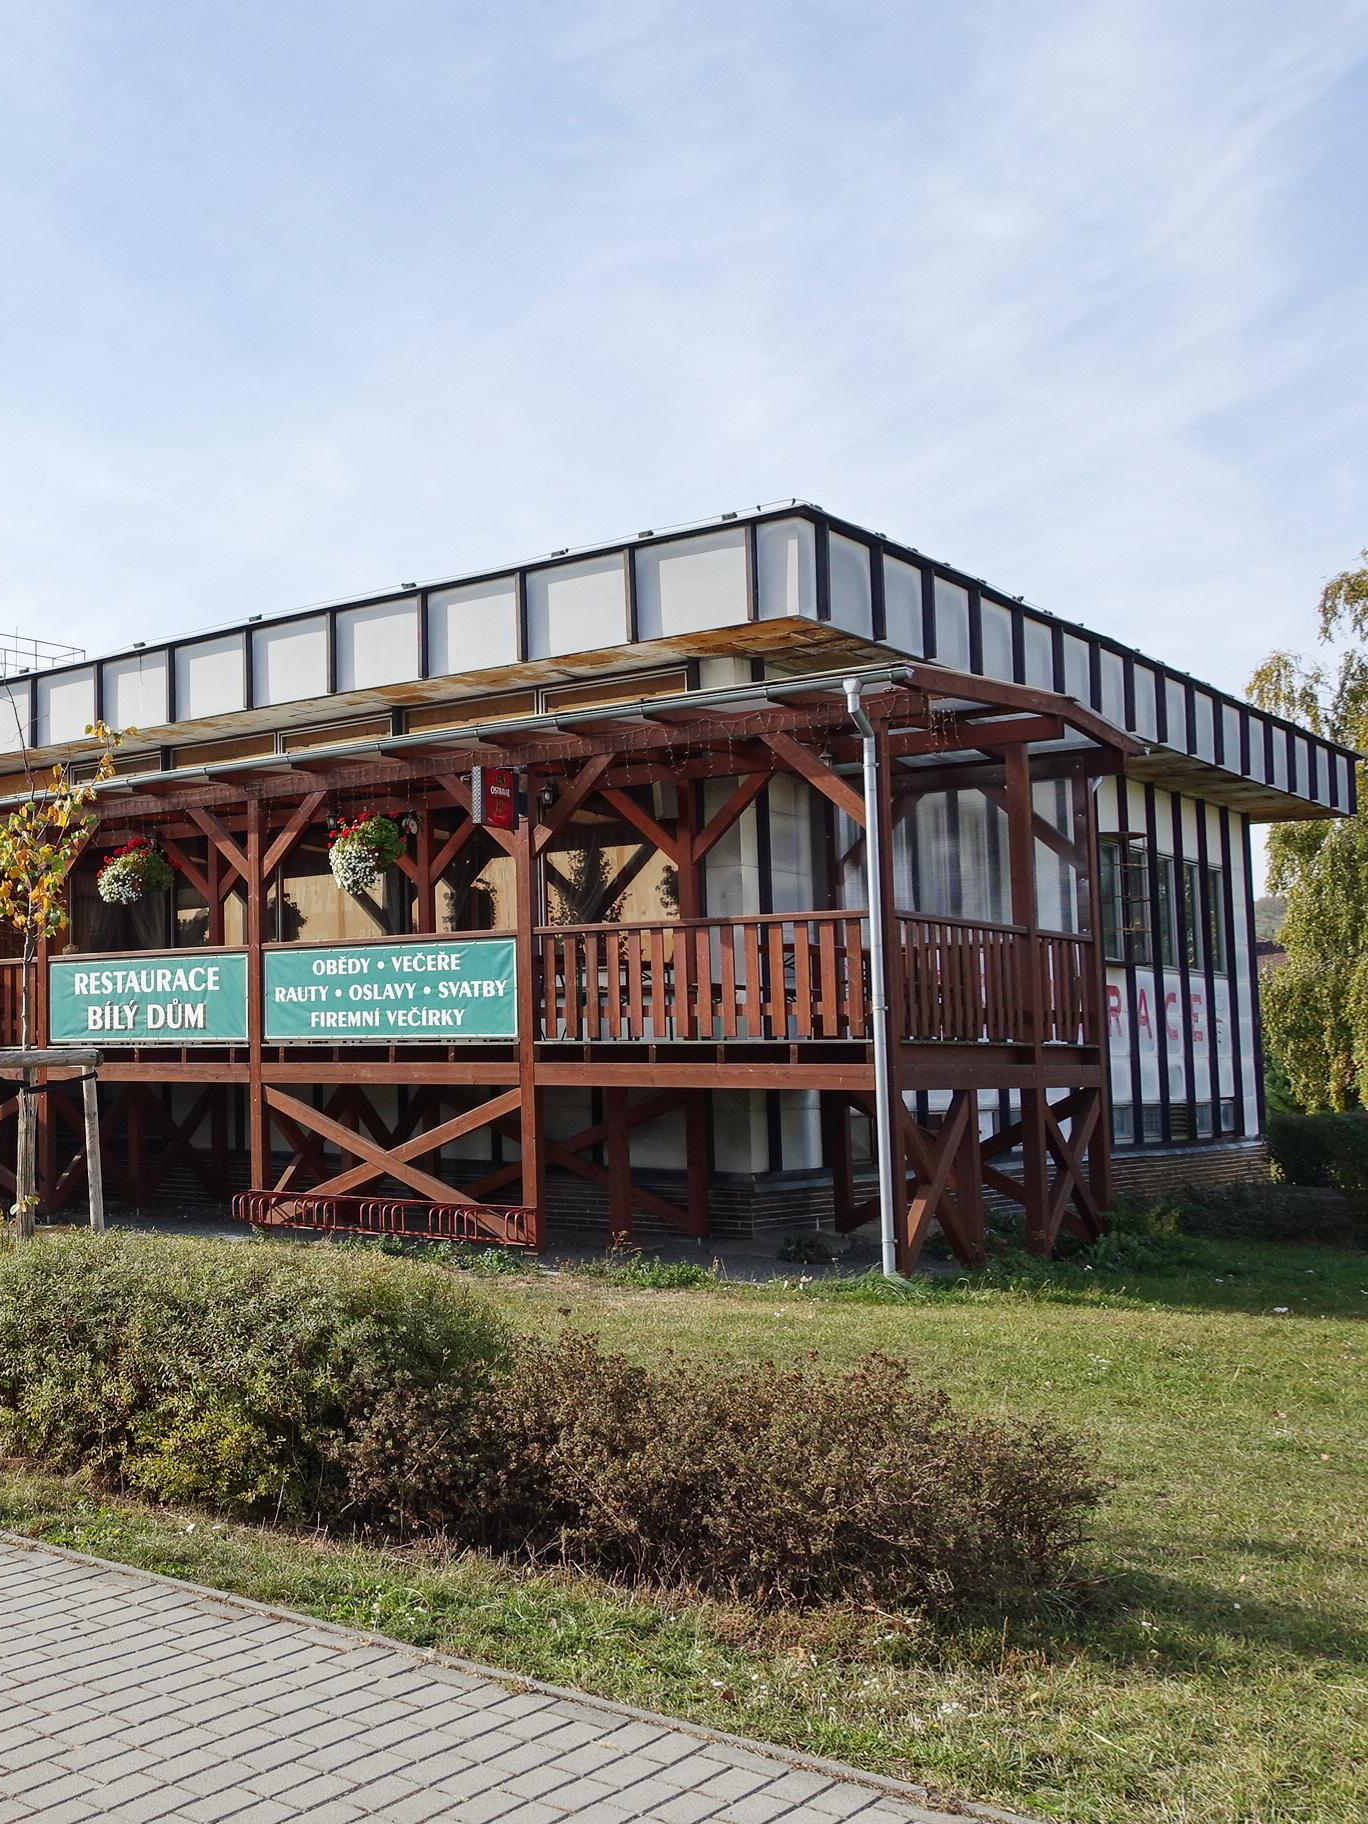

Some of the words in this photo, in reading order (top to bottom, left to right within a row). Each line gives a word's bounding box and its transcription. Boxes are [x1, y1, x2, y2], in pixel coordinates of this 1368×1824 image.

[312, 956, 371, 976] OBĚDY
[391, 951, 461, 972] VEČEŘE
[74, 966, 220, 995] RESTAURACE
[275, 984, 329, 1002] RAUTY
[348, 982, 417, 1001] OSLAVY
[438, 979, 508, 999] SVATBY
[87, 999, 140, 1031] BÍLÝ
[147, 997, 206, 1030] DŮM
[310, 1007, 380, 1028] FIREMNÍ
[386, 1006, 466, 1027] VEČÍRKY
